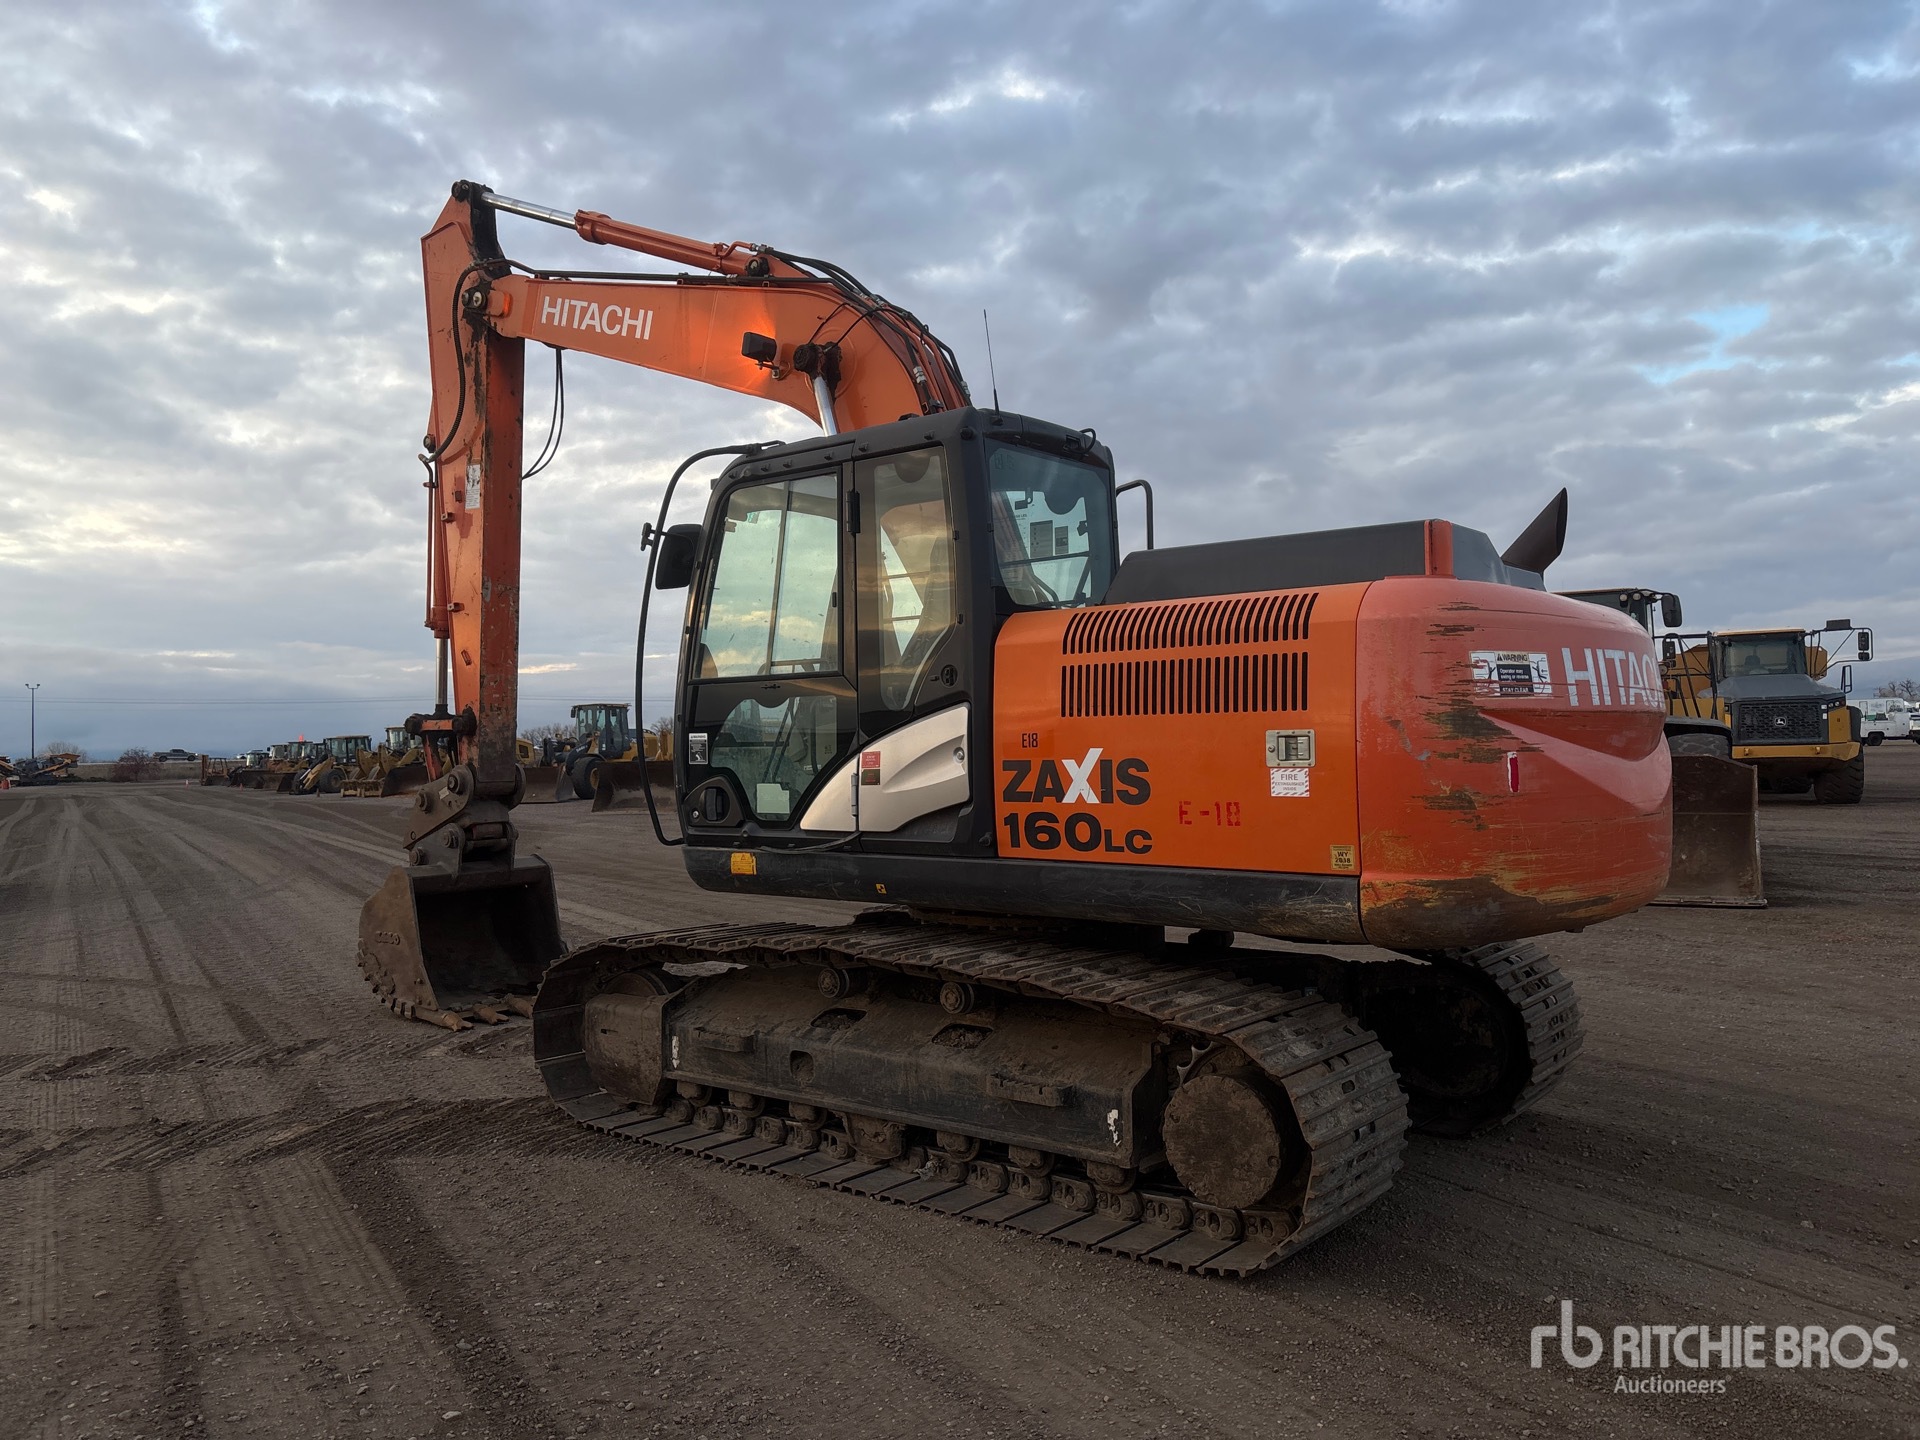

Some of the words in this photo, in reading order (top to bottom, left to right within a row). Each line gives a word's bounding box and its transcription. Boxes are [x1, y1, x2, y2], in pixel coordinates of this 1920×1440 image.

[541, 296, 653, 340] HITACHI
[1502, 654, 1528, 662] WARNING
[1022, 733, 1038, 748] E18
[1002, 748, 1151, 805] ZAXIS
